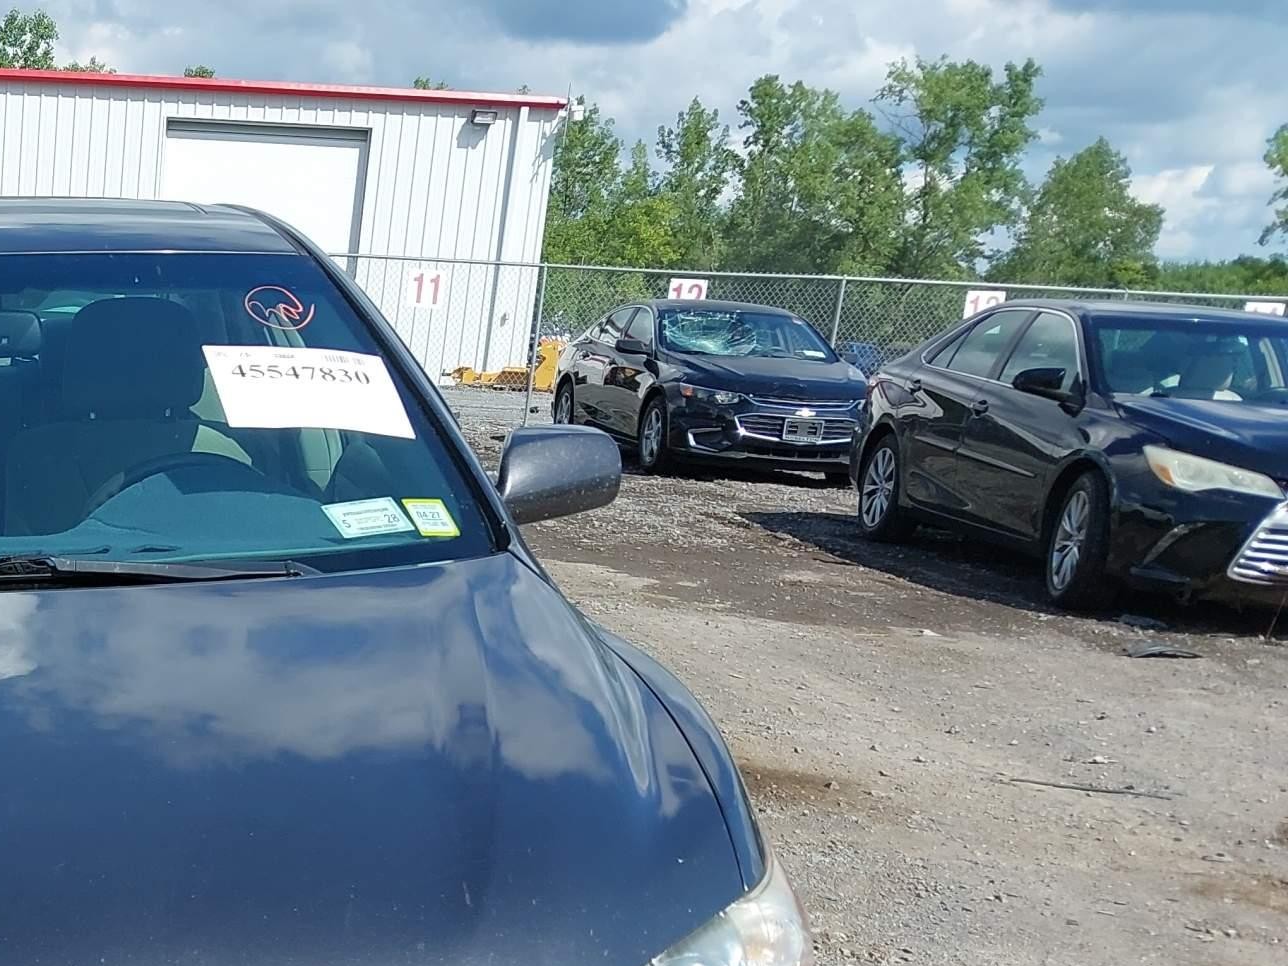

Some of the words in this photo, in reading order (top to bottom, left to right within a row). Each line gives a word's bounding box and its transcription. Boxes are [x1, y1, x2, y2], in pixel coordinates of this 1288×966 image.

[413, 272, 441, 305] 11
[231, 364, 370, 385] 45547830
[383, 513, 400, 524] 28
